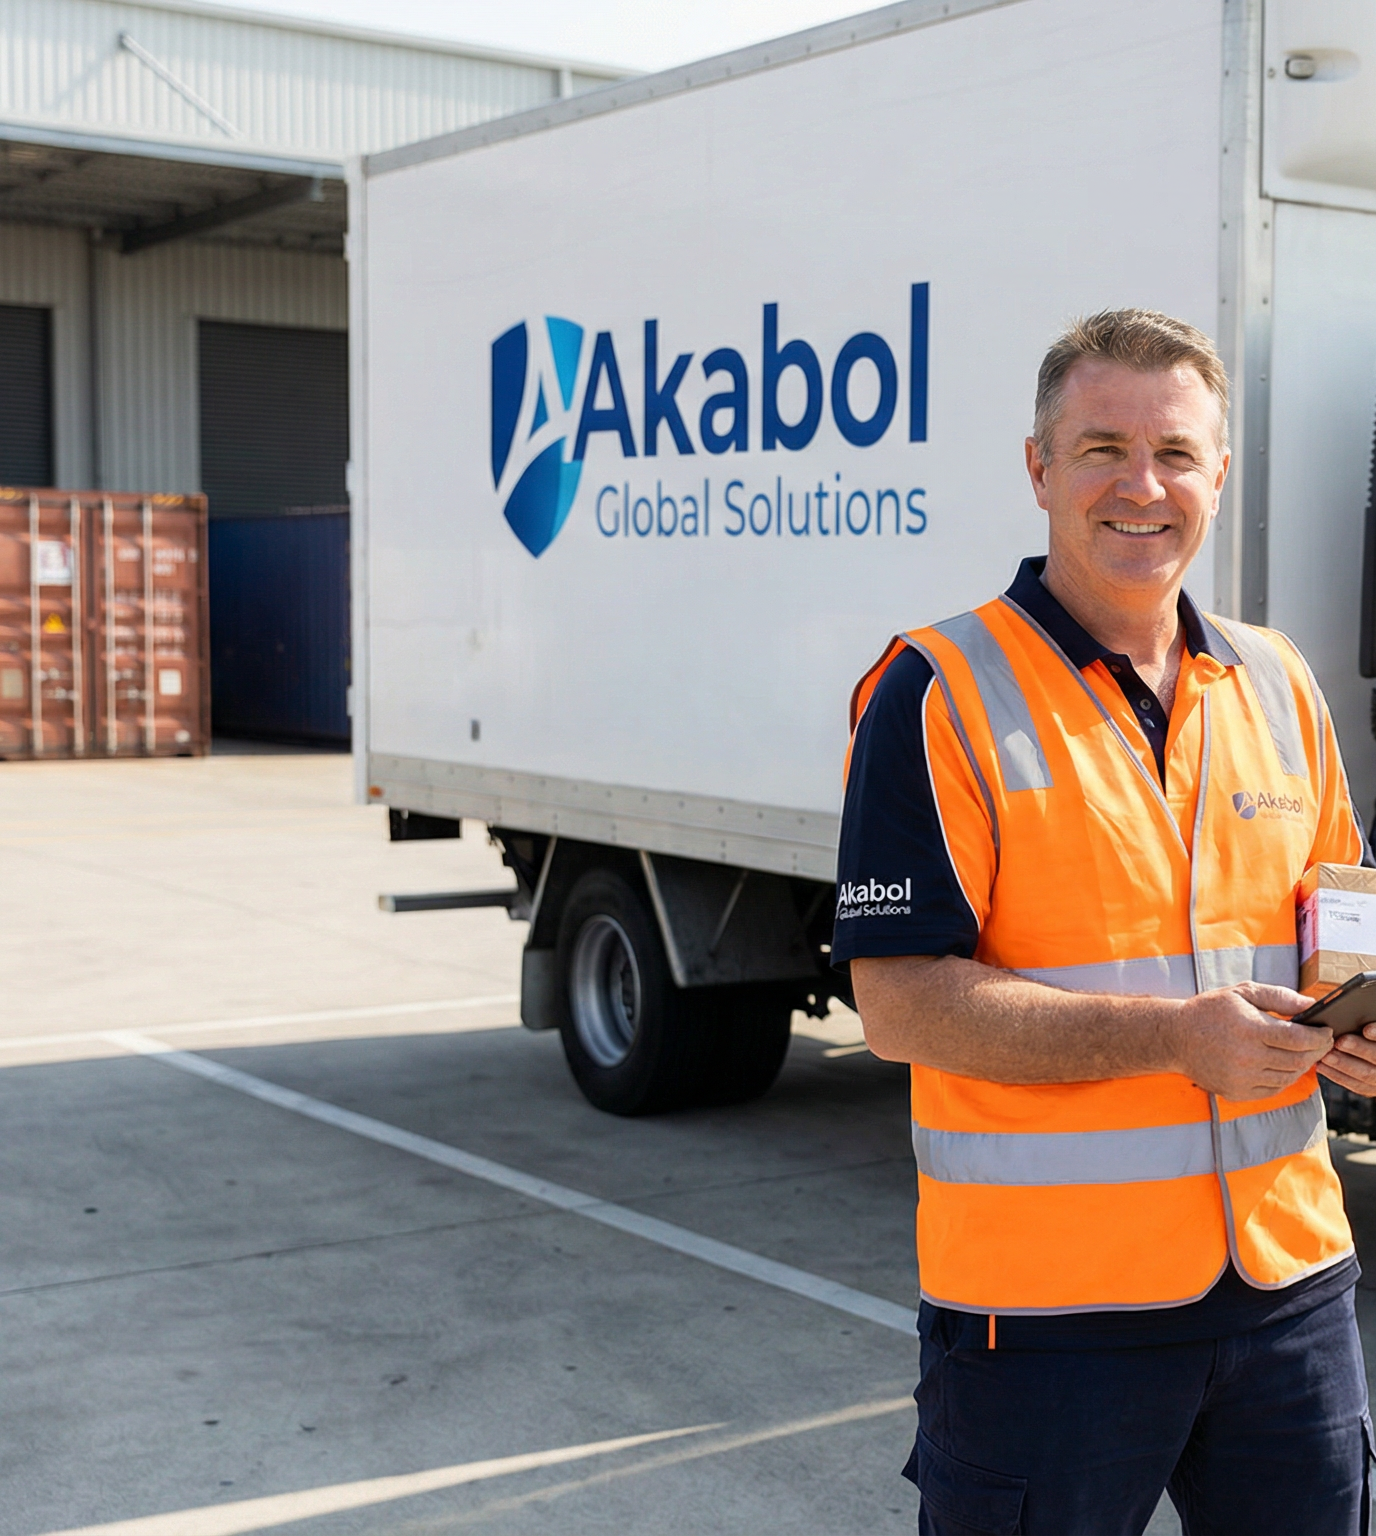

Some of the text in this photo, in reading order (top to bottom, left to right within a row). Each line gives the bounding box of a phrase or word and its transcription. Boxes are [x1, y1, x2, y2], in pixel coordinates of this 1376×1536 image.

[572, 281, 930, 461] Akabol
[596, 472, 928, 538] Global Solutions
[838, 877, 912, 906] Akabol
